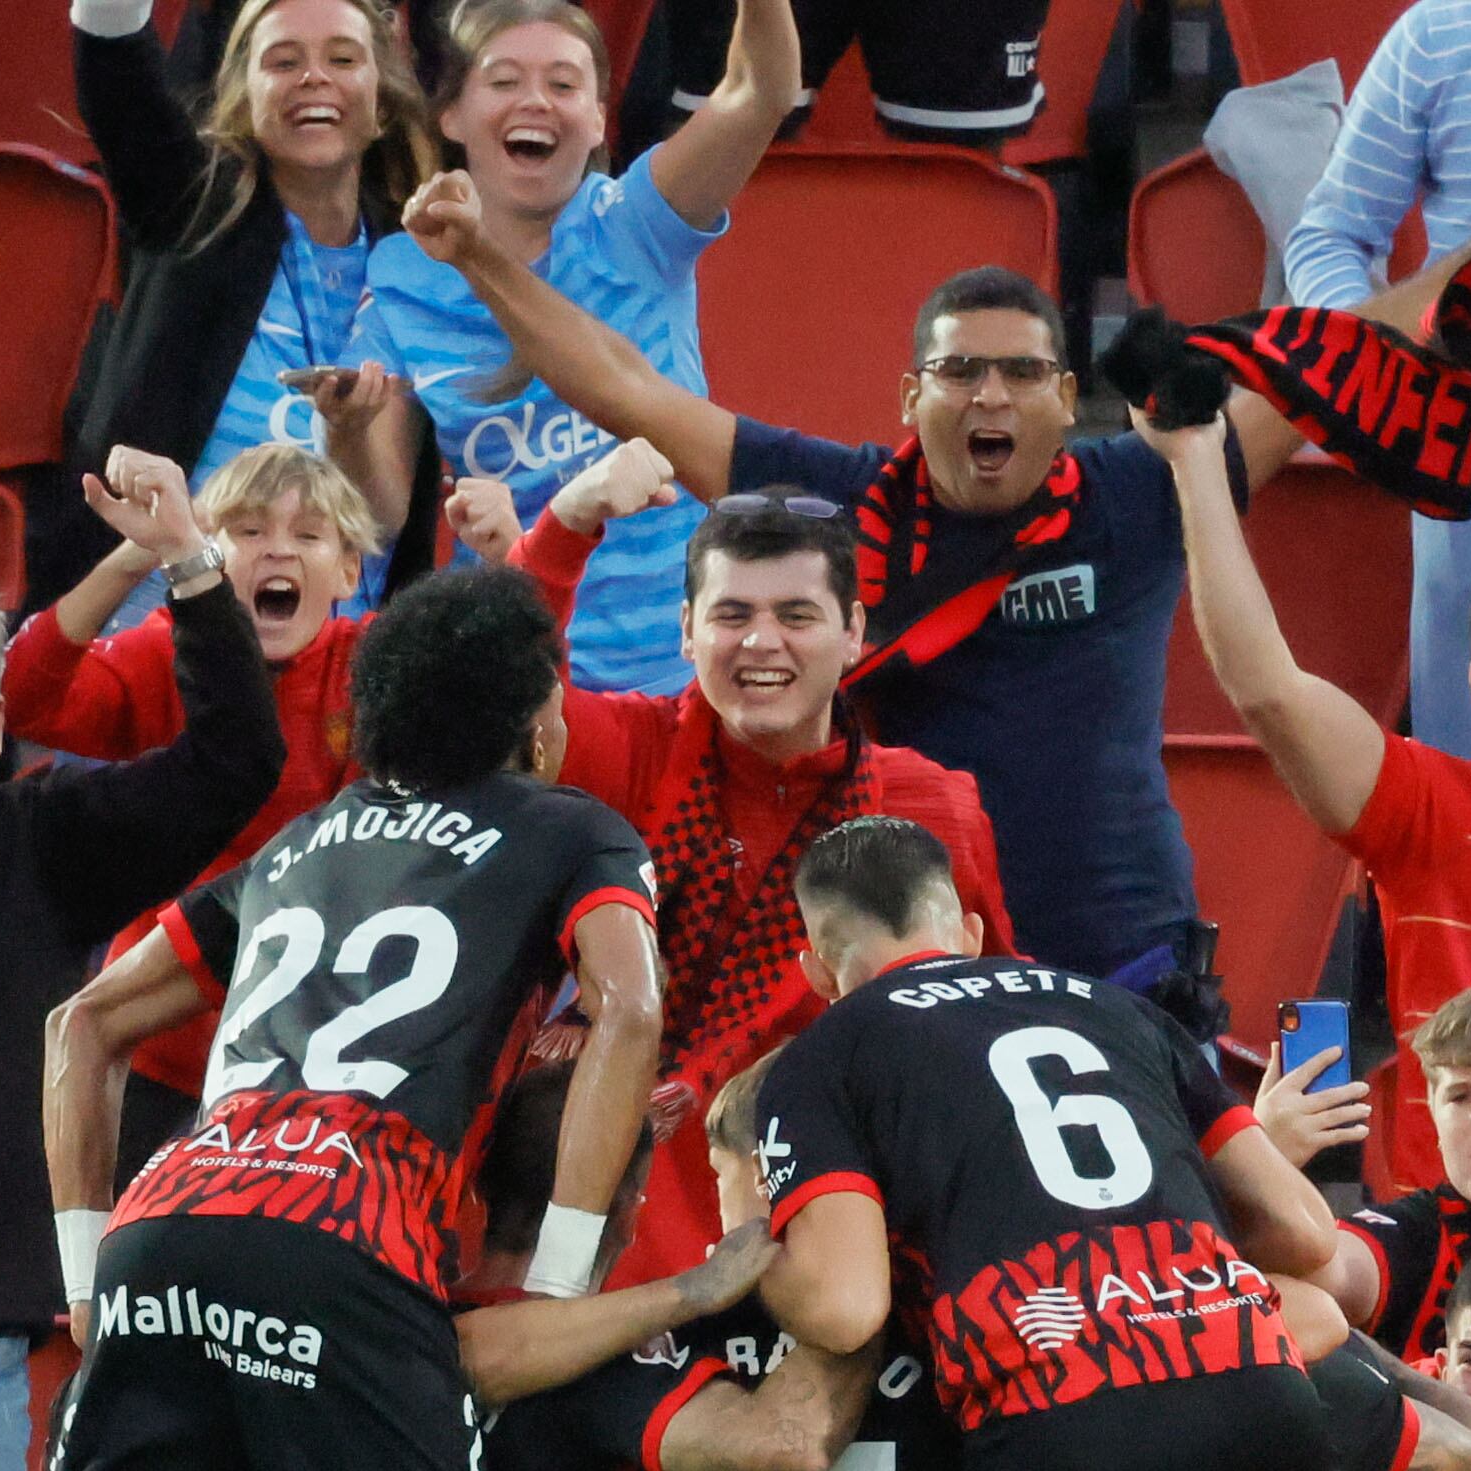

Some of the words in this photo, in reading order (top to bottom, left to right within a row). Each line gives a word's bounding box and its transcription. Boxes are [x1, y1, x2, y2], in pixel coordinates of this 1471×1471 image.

[267, 802, 502, 883] J.MOJICA
[202, 905, 458, 1110] 22
[888, 969, 1093, 1009] COPETE
[184, 1117, 363, 1169] ALUA
[988, 1026, 1153, 1210] 6
[191, 1156, 249, 1168] HOTELS
[251, 1158, 263, 1169] &
[267, 1160, 338, 1180] RESORTS
[1097, 1260, 1268, 1312] ALUA
[1127, 1309, 1186, 1324] HOTELS
[1201, 1292, 1263, 1315] RESORTS
[97, 1284, 324, 1367] Mallorca
[236, 1353, 317, 1390] Balears
